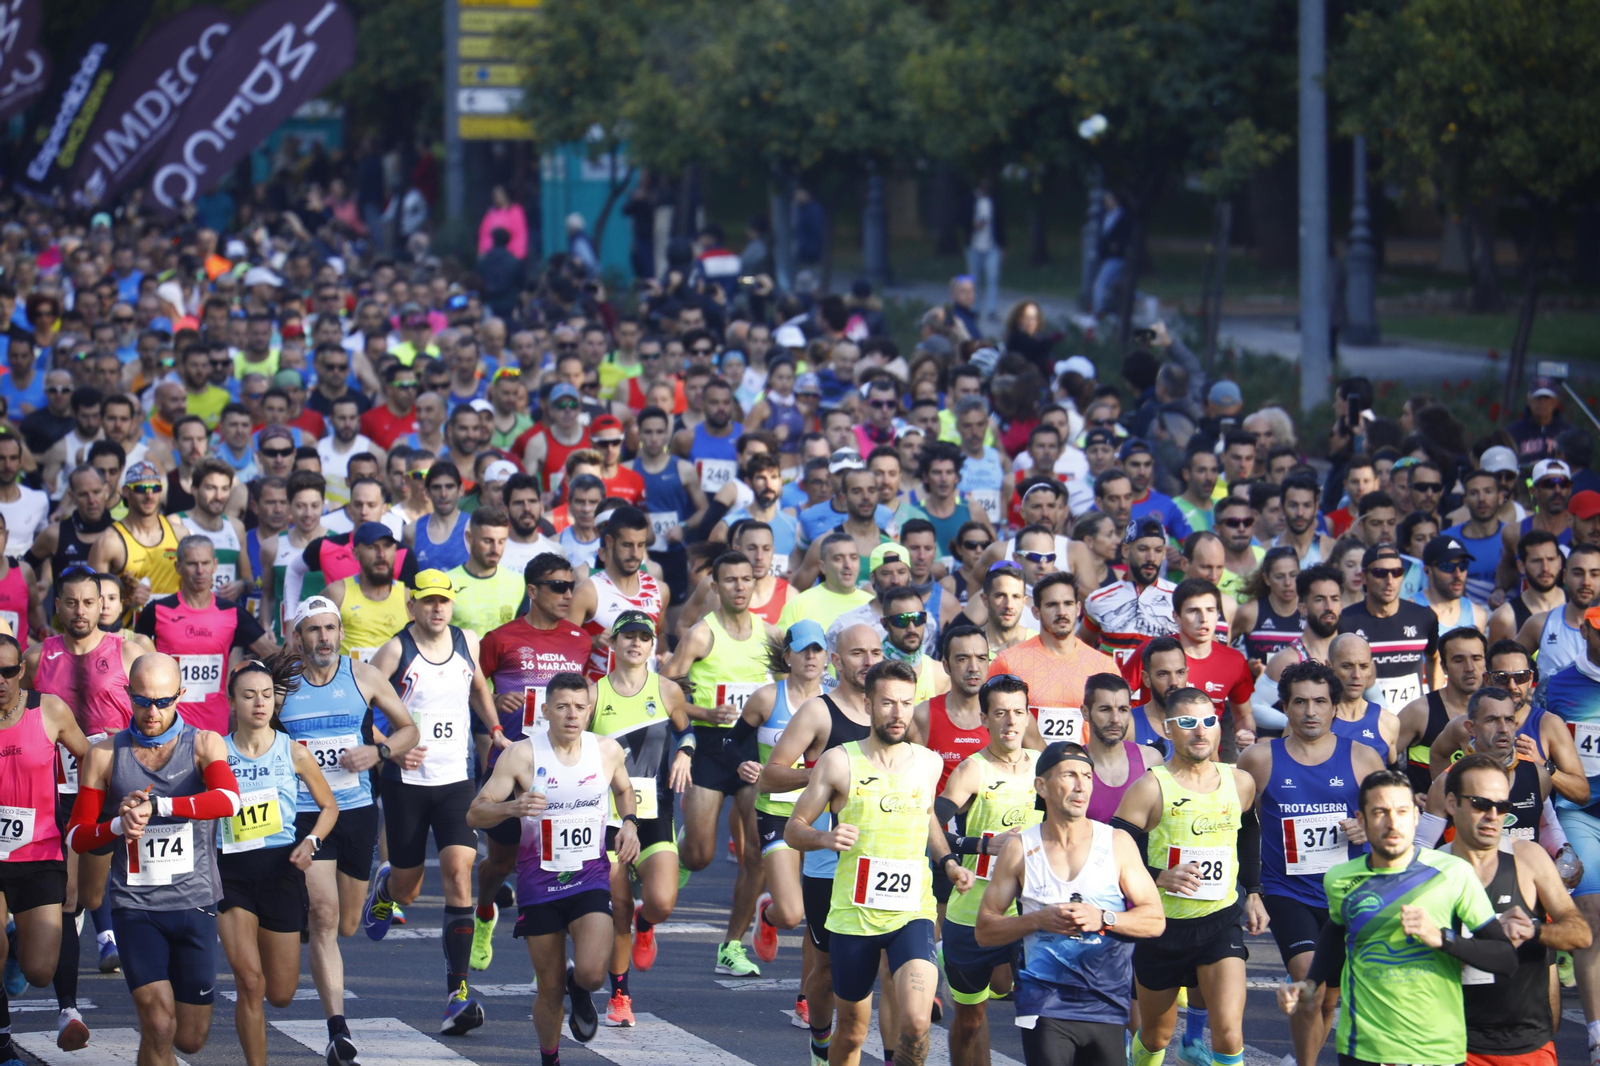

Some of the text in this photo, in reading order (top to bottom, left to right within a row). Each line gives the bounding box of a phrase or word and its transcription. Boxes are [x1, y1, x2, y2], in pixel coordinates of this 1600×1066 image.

[152, 1, 337, 208] IMDECO
[706, 467, 730, 481] 248
[520, 660, 582, 671] 36 MARATÓN
[536, 653, 567, 662] MEDIA
[181, 665, 219, 681] 1885
[290, 718, 324, 733] MEDIA
[433, 721, 454, 739] 65
[1043, 718, 1074, 737] 225
[232, 765, 270, 780] erja
[543, 802, 564, 811] ERRA
[572, 799, 600, 810] SEGURA
[1278, 803, 1348, 813] TROTASIERRA
[236, 802, 269, 827] 117
[1, 817, 24, 838] 79
[560, 826, 592, 847] 160
[1303, 825, 1338, 848] 371
[145, 836, 184, 858] 174
[1189, 860, 1222, 881] 28
[875, 871, 911, 893] 229
